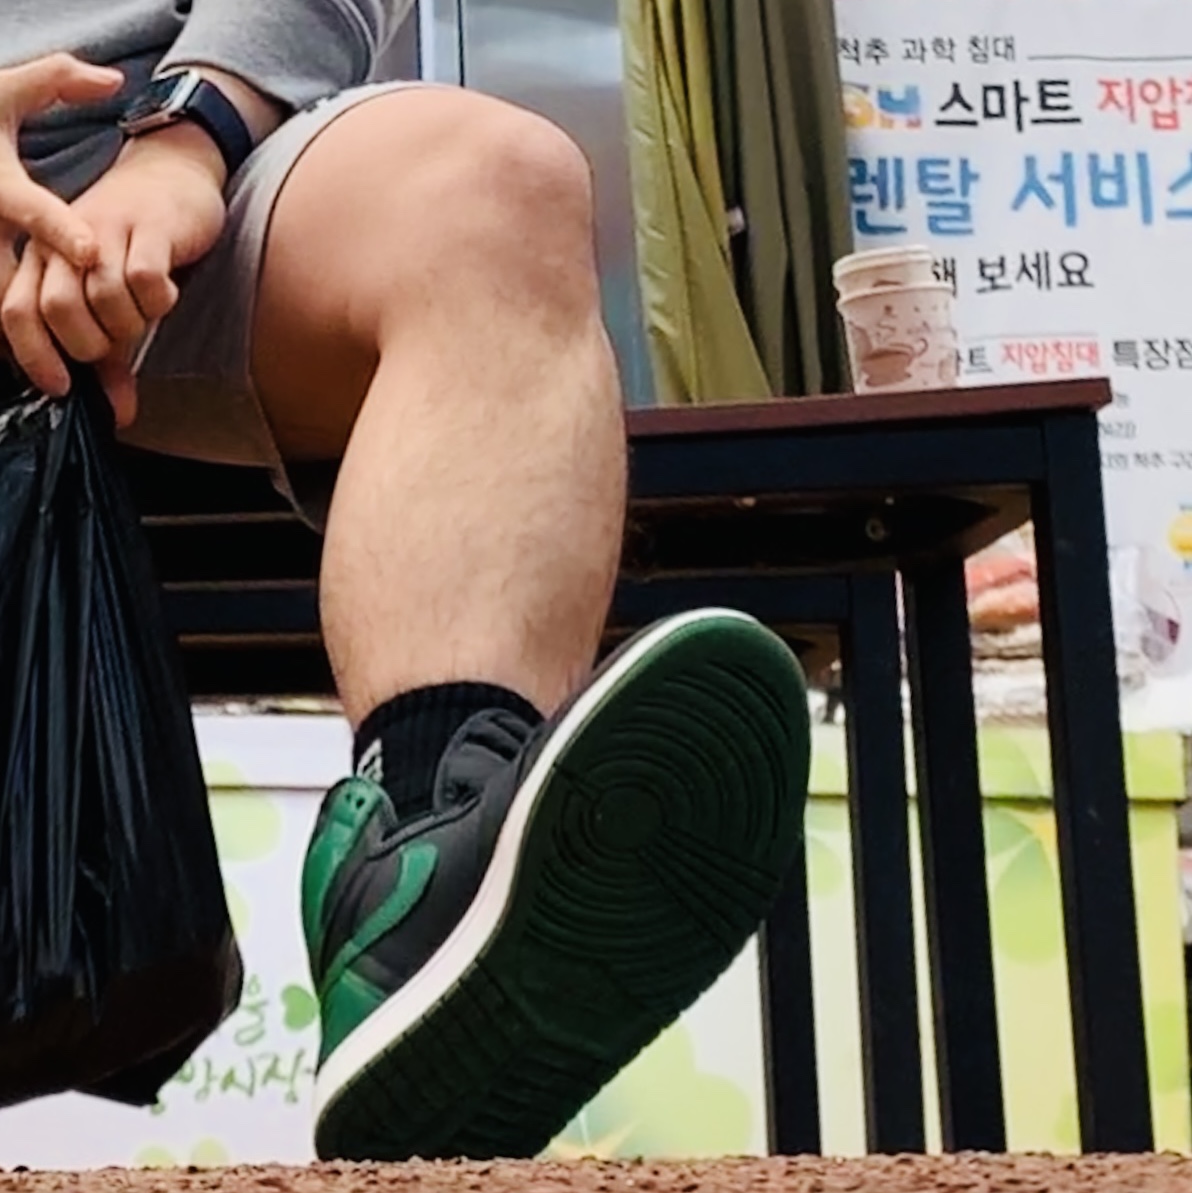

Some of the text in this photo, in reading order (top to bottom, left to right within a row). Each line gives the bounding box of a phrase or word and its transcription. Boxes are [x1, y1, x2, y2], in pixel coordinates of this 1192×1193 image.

[901, 37, 957, 64] 과학
[967, 35, 1016, 64] 침대
[934, 78, 1083, 133] 스마트
[1096, 76, 1192, 131] 지압
[847, 155, 980, 236] 렌탈
[976, 250, 1095, 294] 보세요
[1000, 339, 1100, 376] 지압침대
[149, 1048, 315, 1116] 앙시장
